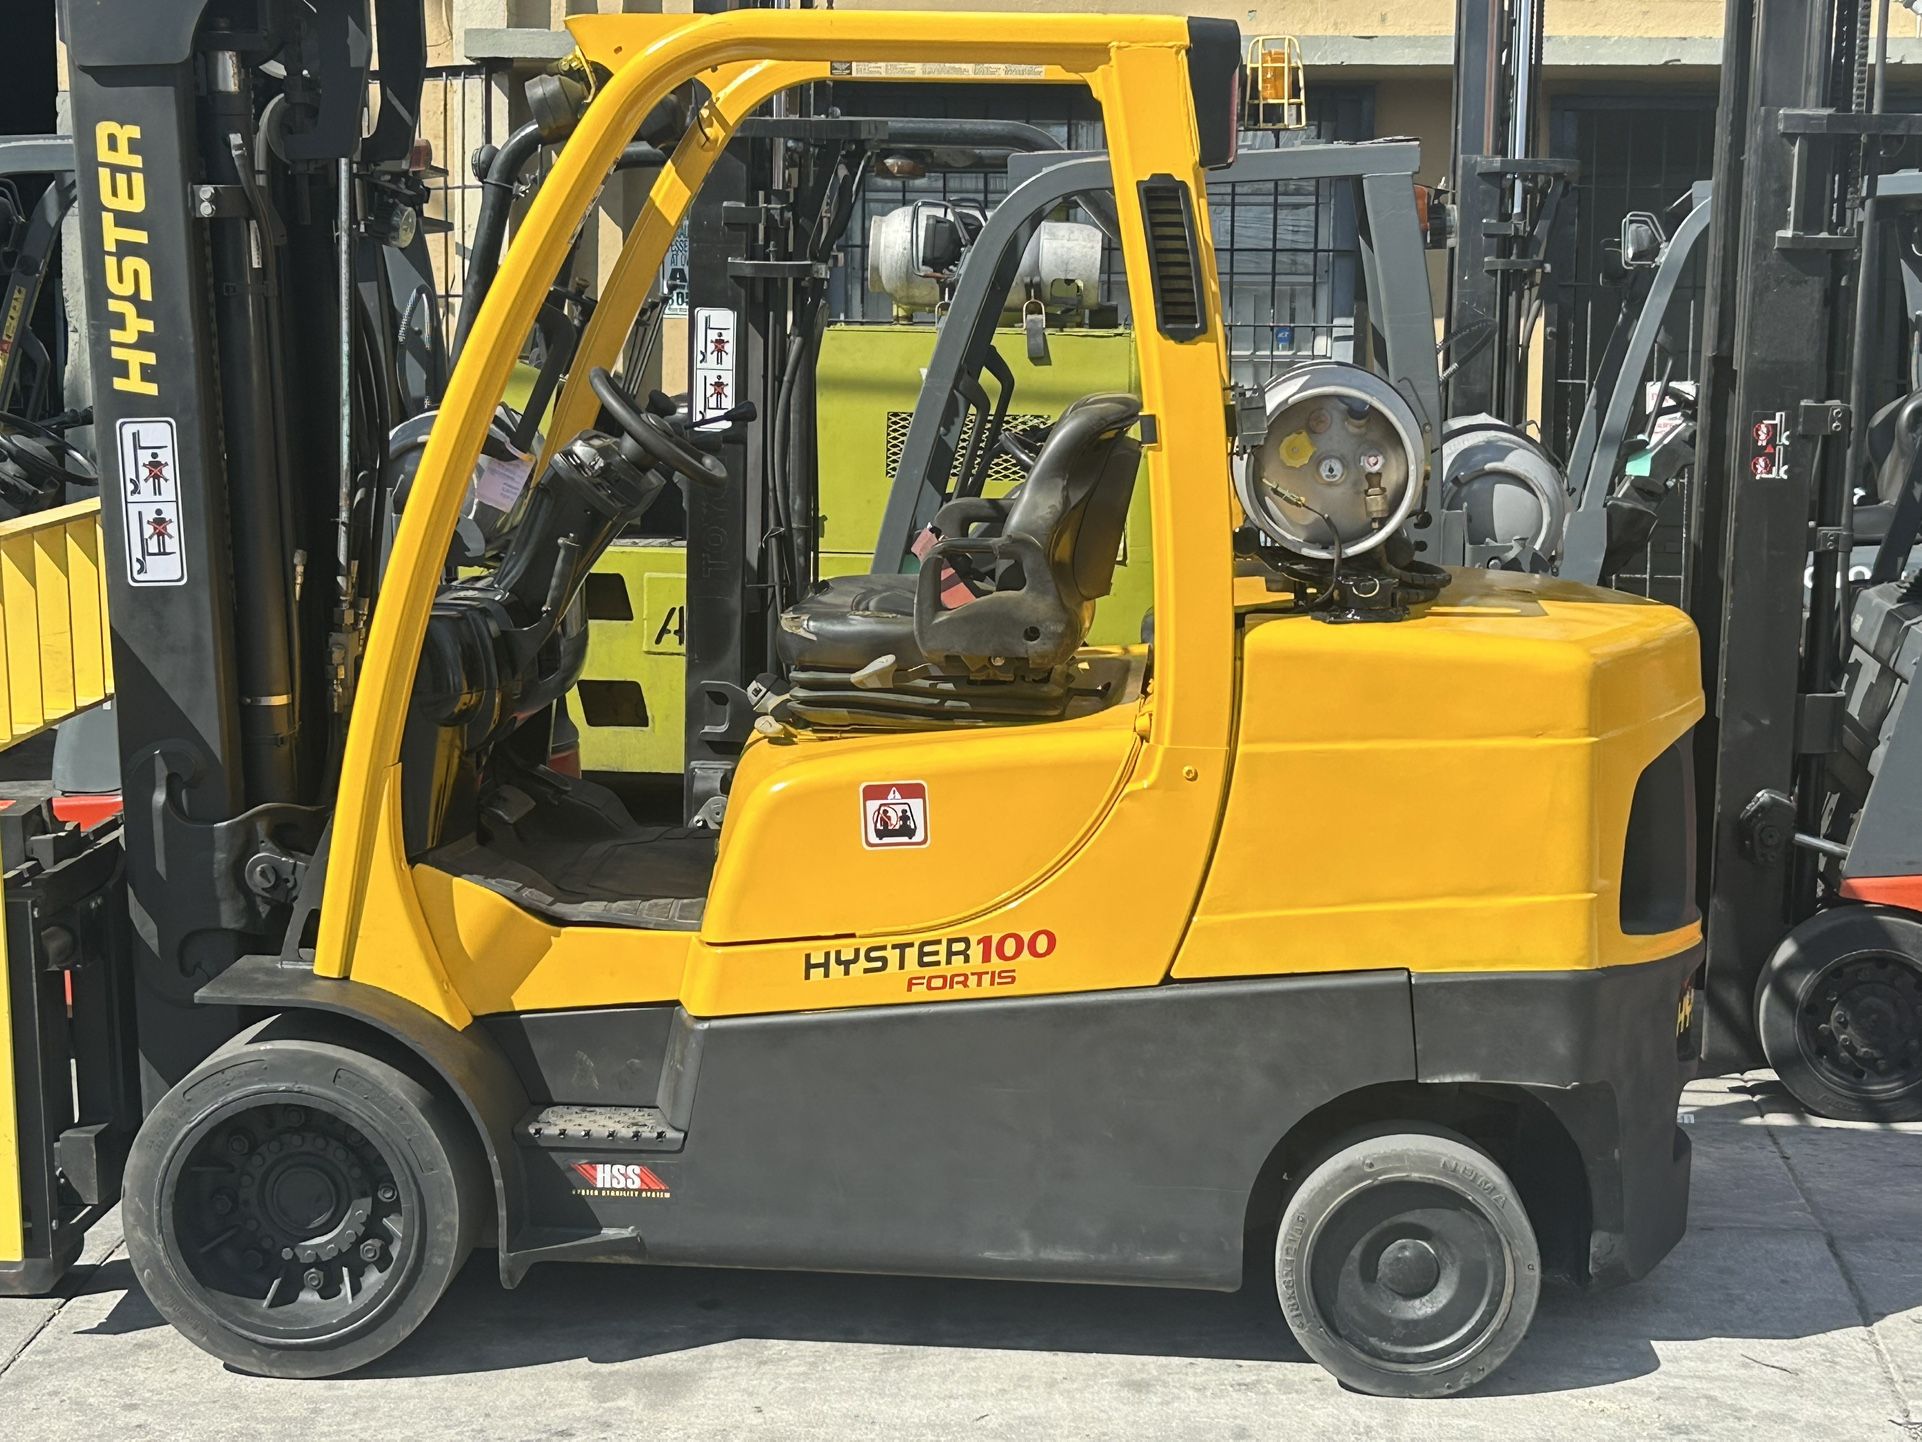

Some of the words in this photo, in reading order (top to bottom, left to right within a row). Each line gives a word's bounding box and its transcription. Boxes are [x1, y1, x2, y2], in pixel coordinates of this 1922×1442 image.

[95, 119, 159, 396] HYSTER
[907, 969, 1016, 992] FORTIS
[596, 1163, 642, 1189] HSS
